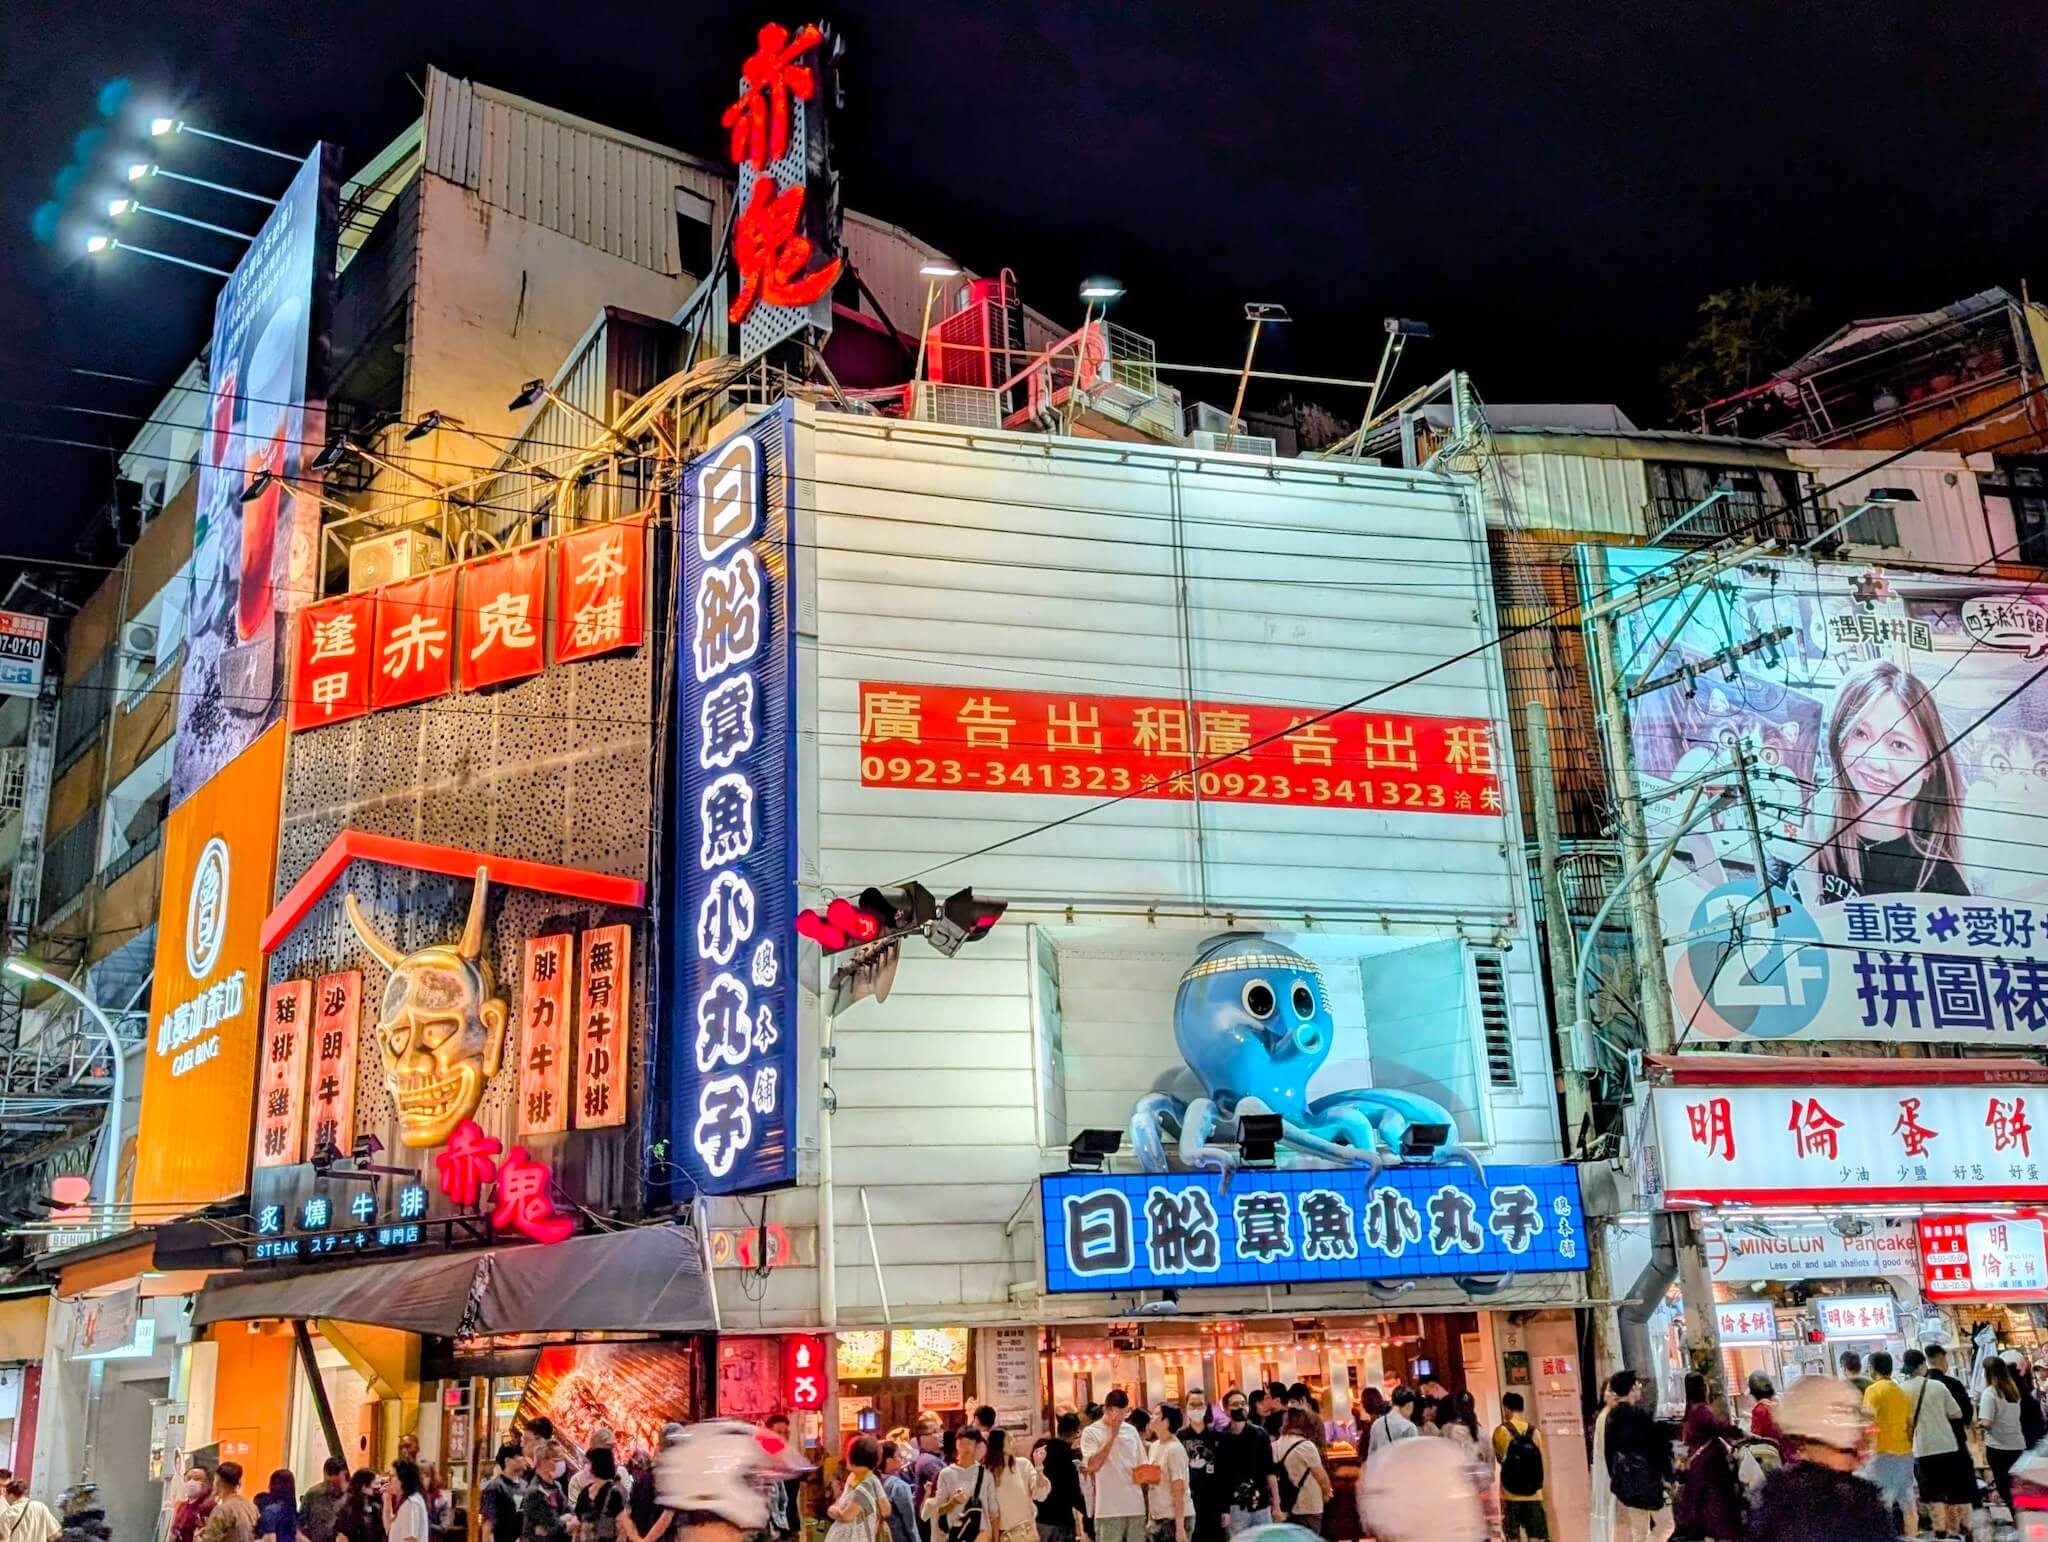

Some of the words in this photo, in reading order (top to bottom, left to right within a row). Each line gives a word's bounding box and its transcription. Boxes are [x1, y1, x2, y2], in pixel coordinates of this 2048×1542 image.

[0, 635, 40, 657] 7-0710
[310, 613, 357, 716] 逢甲
[574, 542, 628, 649] 本舖
[860, 690, 1192, 758] 廣告出租
[1199, 710, 1497, 775] 廣告出租
[693, 434, 760, 1178] 日船章魚小丸子
[861, 756, 1131, 791] 0923-341323
[1199, 772, 1446, 809] 0923-341323
[1705, 894, 1824, 1006] 2F
[1844, 902, 1921, 945] 重度
[1962, 906, 2036, 949] 愛好
[1852, 950, 2048, 1032] 拼圖裱
[527, 949, 558, 1125] 腓力牛排
[584, 941, 614, 1118] 無骨牛小排
[314, 986, 346, 1146] 沙朗牛排
[1685, 1096, 2032, 1162] 明倫蛋餅
[436, 1118, 577, 1245] 赤鬼
[1838, 1164, 1871, 1183] 少油
[2008, 1162, 2040, 1181] 好蛋
[258, 1186, 424, 1234] 炙燒牛排
[1063, 1184, 1542, 1277] 日船章魚小丸子
[256, 1240, 299, 1258] STEAK
[310, 1234, 367, 1255] ステーキ
[1739, 1235, 1825, 1255] MINGLUN
[1769, 1260, 1788, 1270] Less
[1791, 1260, 1801, 1270] oil
[1804, 1259, 1820, 1269] and
[1823, 1258, 1838, 1268] salt
[1882, 1257, 1901, 1268] good
[1827, 1306, 1886, 1329] 明倫蛋餅
